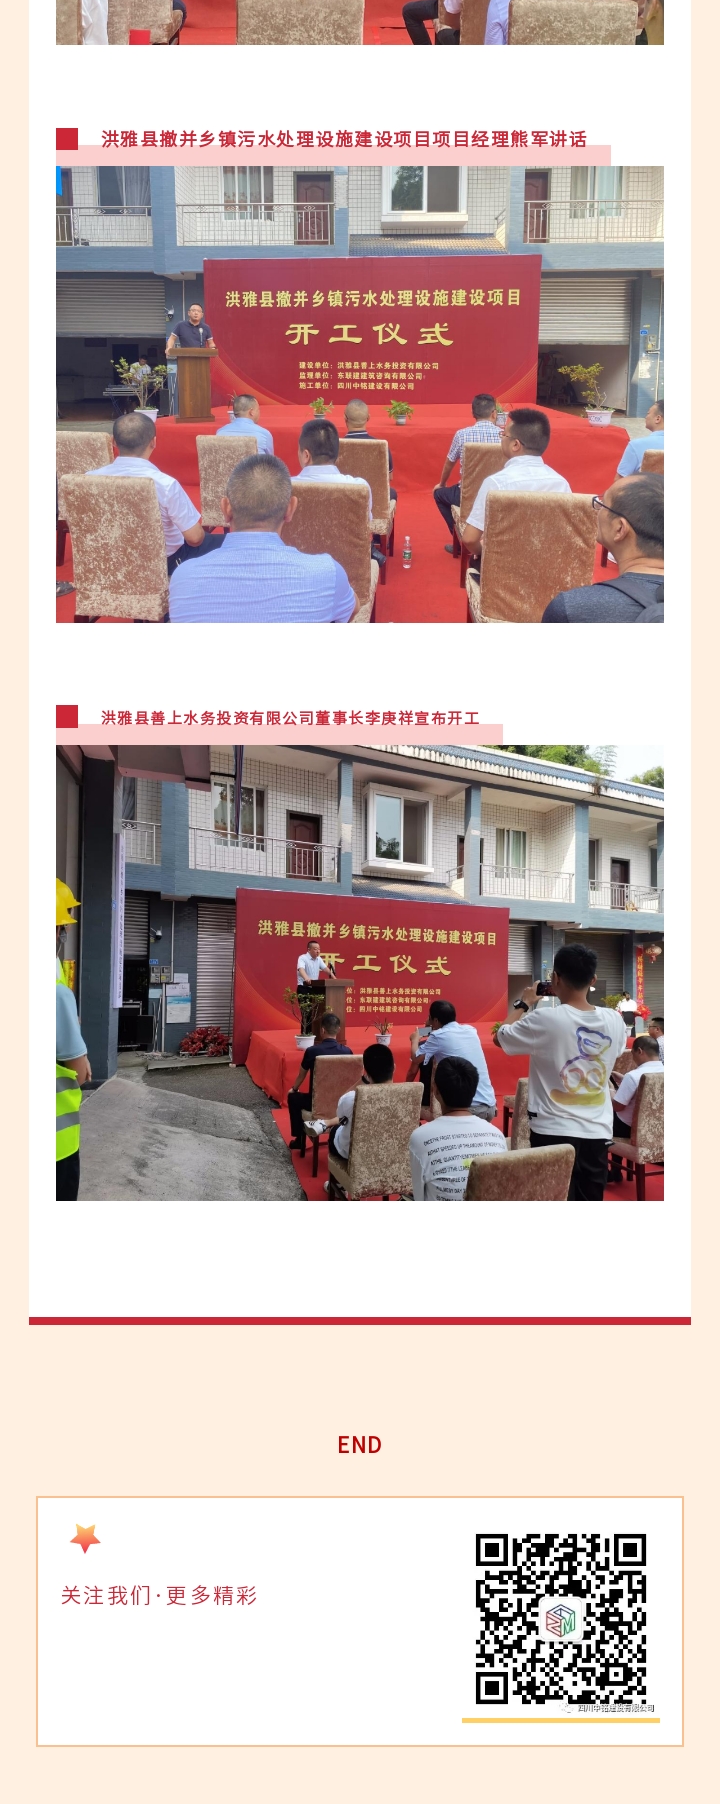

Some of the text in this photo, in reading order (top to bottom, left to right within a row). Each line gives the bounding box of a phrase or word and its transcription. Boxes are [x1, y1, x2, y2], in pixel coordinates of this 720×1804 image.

[101, 129, 587, 148] 洪雅县撤并乡镇污水处理设施建设项目项目经理熊军讲话
[225, 289, 521, 307] 洪雅县撤并乡镇污水处理设施建设项目
[285, 323, 454, 347] 开工仪式
[101, 710, 479, 726] 洪雅县善上水务投资有限公司董事长李庚祥宣布开工
[258, 920, 497, 946] 洪雅县撤并乡镇污水处理设施建设项目
[338, 1436, 382, 1453] END
